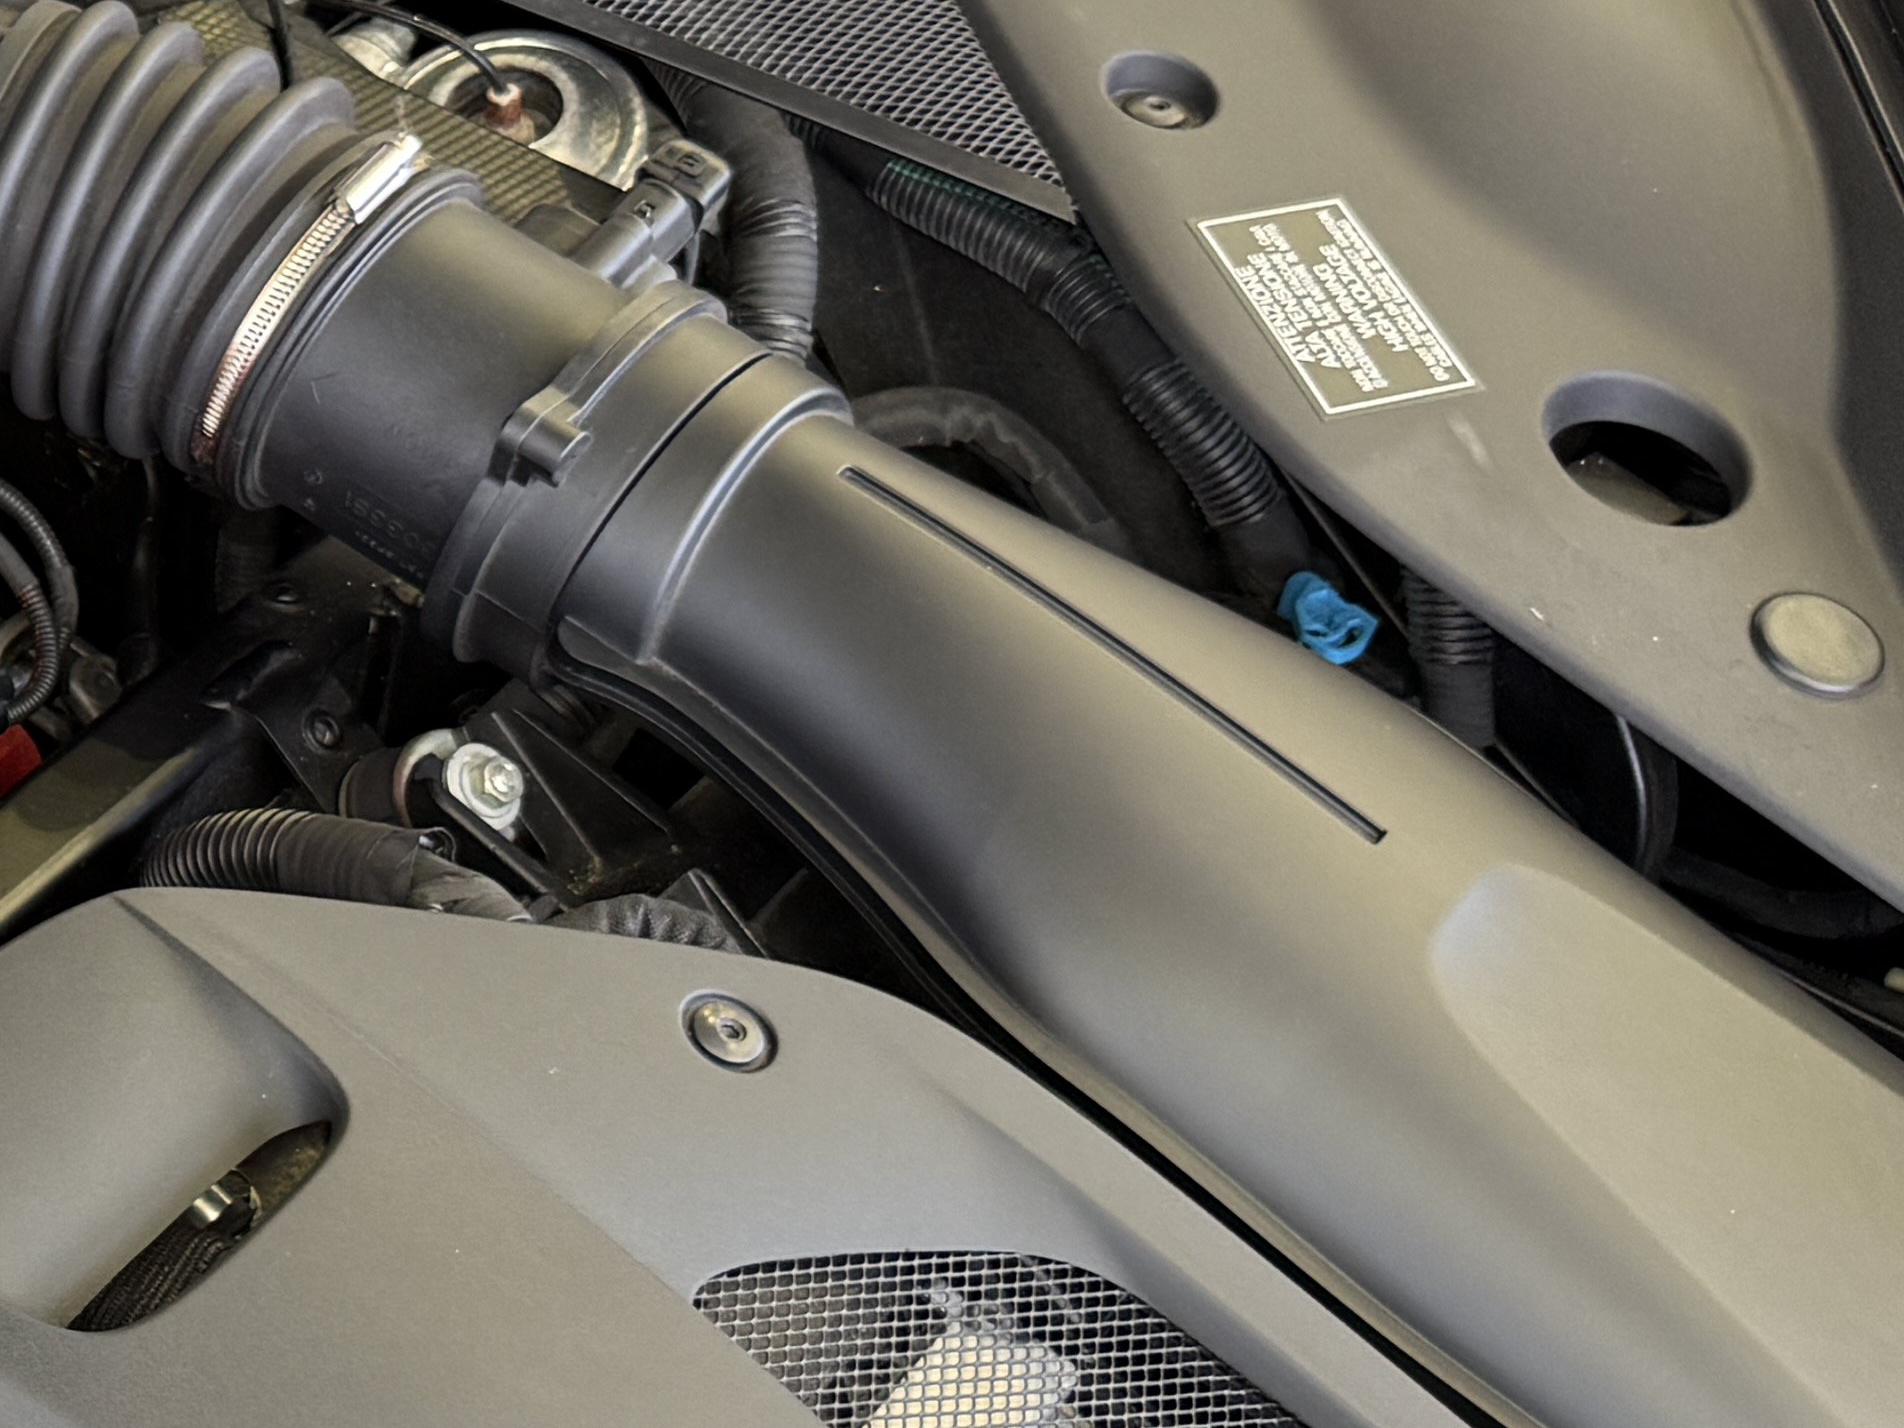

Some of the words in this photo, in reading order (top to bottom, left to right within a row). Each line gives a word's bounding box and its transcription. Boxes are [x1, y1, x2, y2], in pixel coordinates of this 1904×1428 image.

[1247, 252, 1312, 330] TENSIONE
[1312, 262, 1376, 339] WARNING
[1318, 243, 1377, 310] VOLTAGE
[1234, 265, 1315, 364] ATTENZIONE
[1304, 330, 1342, 368] ALTA
[1367, 310, 1409, 352] HIGH
